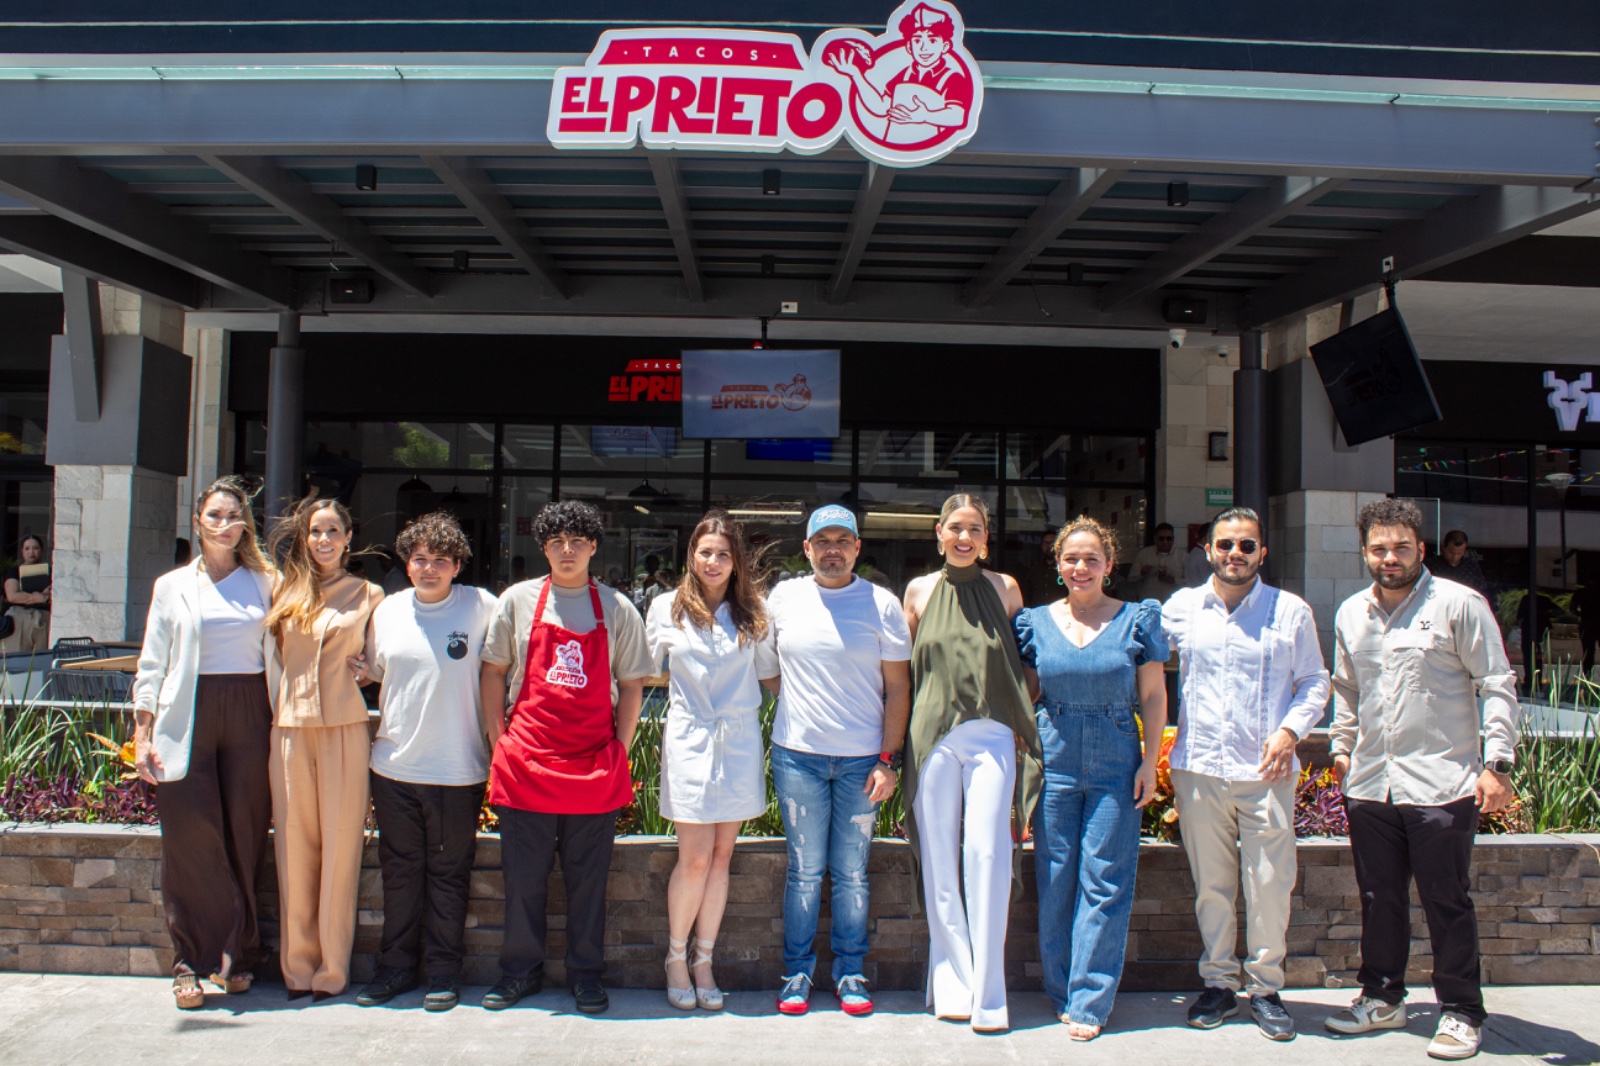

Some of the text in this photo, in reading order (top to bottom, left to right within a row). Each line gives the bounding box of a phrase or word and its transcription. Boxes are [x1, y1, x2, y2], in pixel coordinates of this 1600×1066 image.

[643, 46, 759, 61] TACOS
[558, 75, 843, 139] EL PRIETO
[608, 375, 630, 402] EL
[711, 394, 780, 409] EL PRIETO
[555, 671, 585, 686] PRIETO
